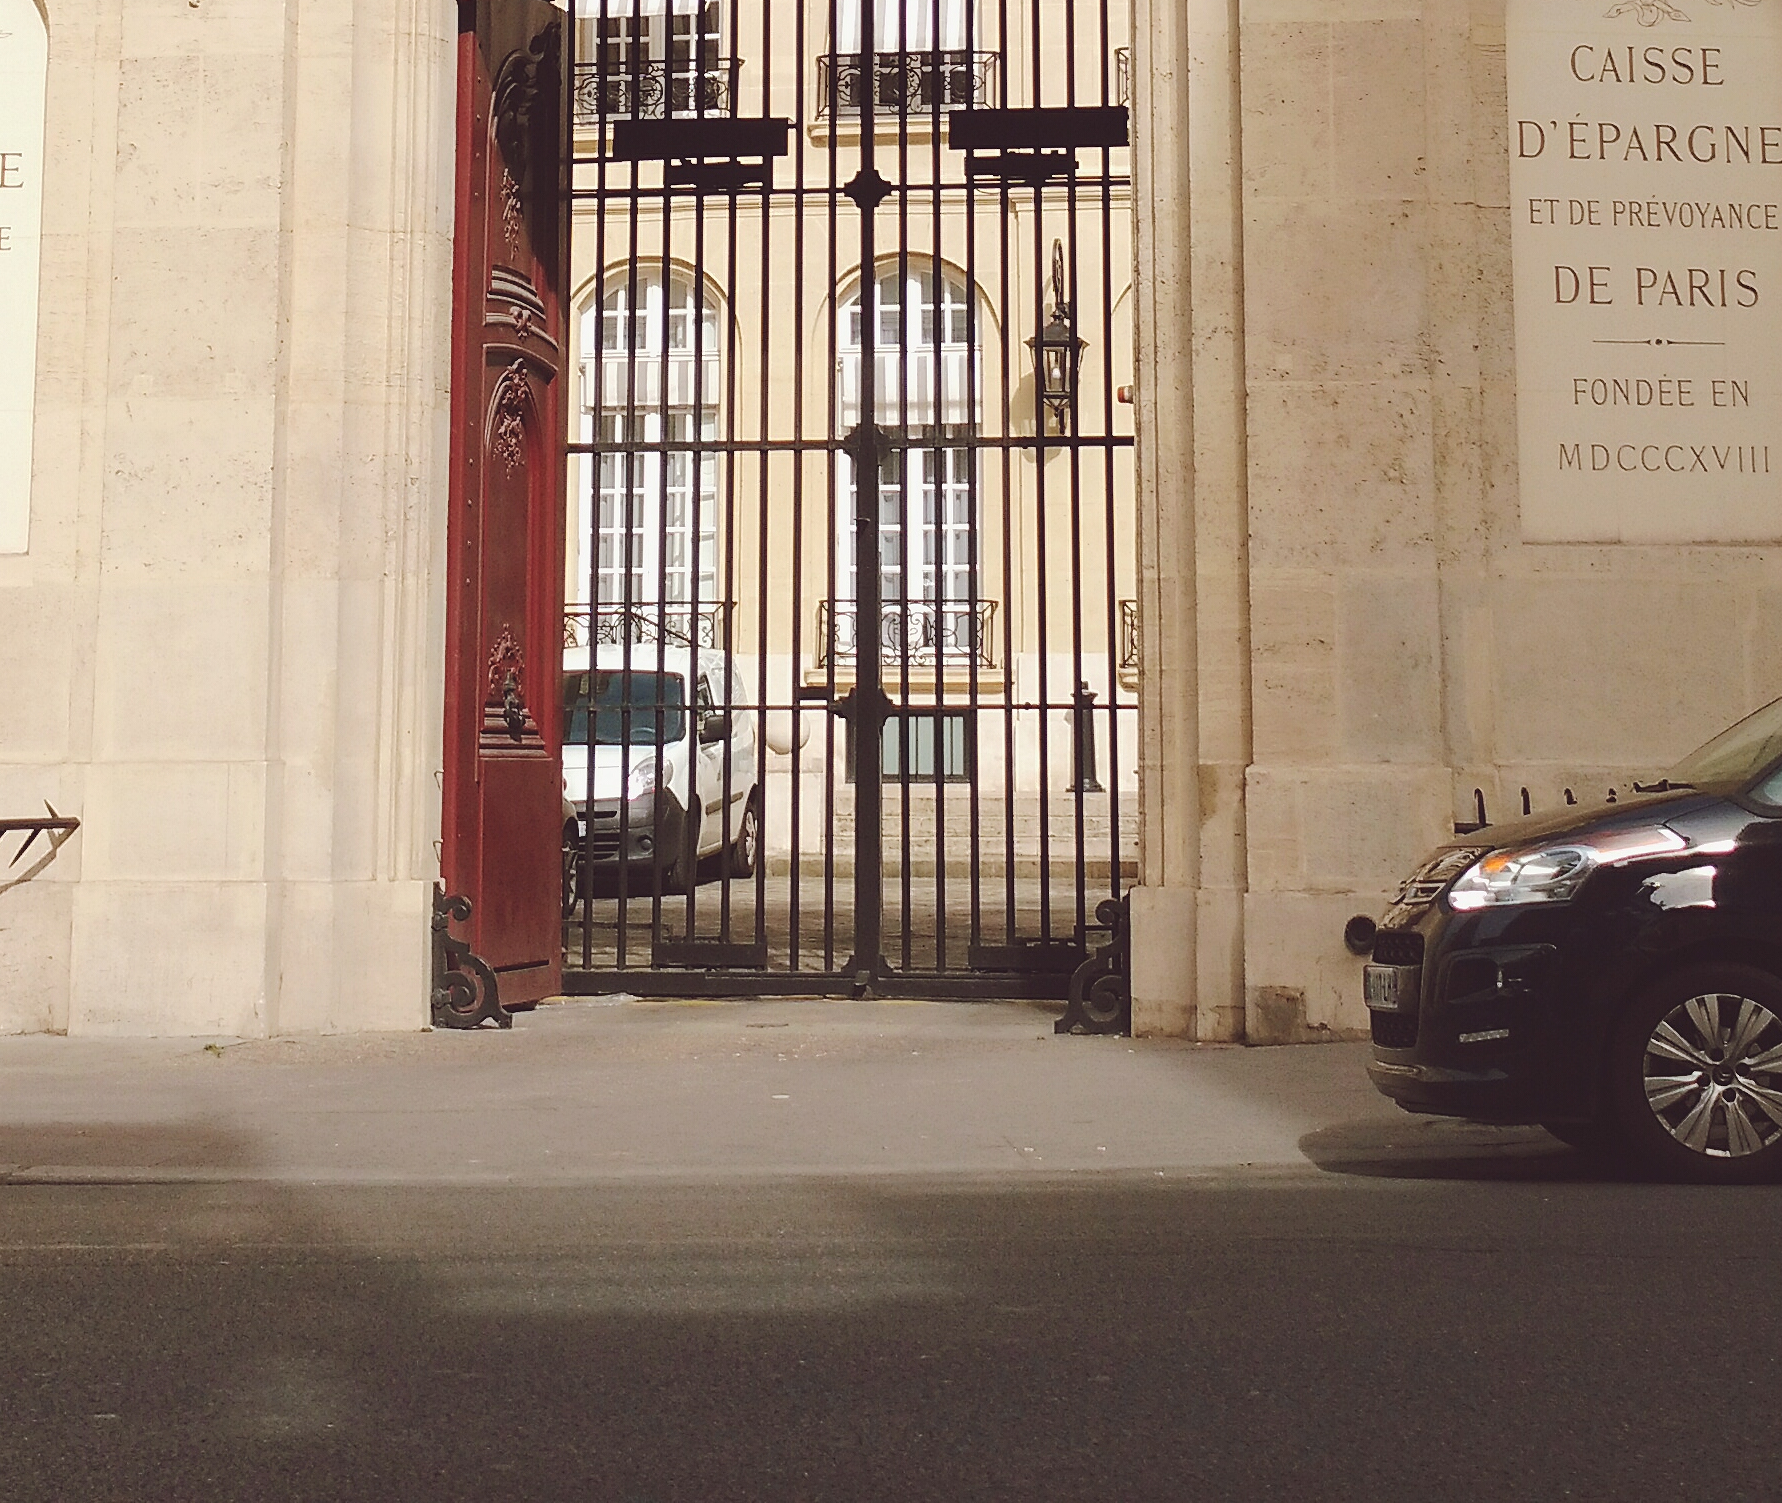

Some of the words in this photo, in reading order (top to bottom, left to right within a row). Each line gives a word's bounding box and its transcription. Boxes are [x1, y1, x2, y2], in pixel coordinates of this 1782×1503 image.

[1569, 44, 1726, 87] CAISSE
[1528, 198, 1559, 225] ET
[1568, 198, 1602, 227] DE
[1612, 194, 1780, 232] PRÉVOYANCE
[1554, 265, 1612, 306] DE
[1635, 266, 1761, 309] PARIS
[1572, 374, 1695, 407] FONDÉE
[1711, 380, 1751, 407] EN
[1558, 443, 1770, 473] MDCCCXVIII
